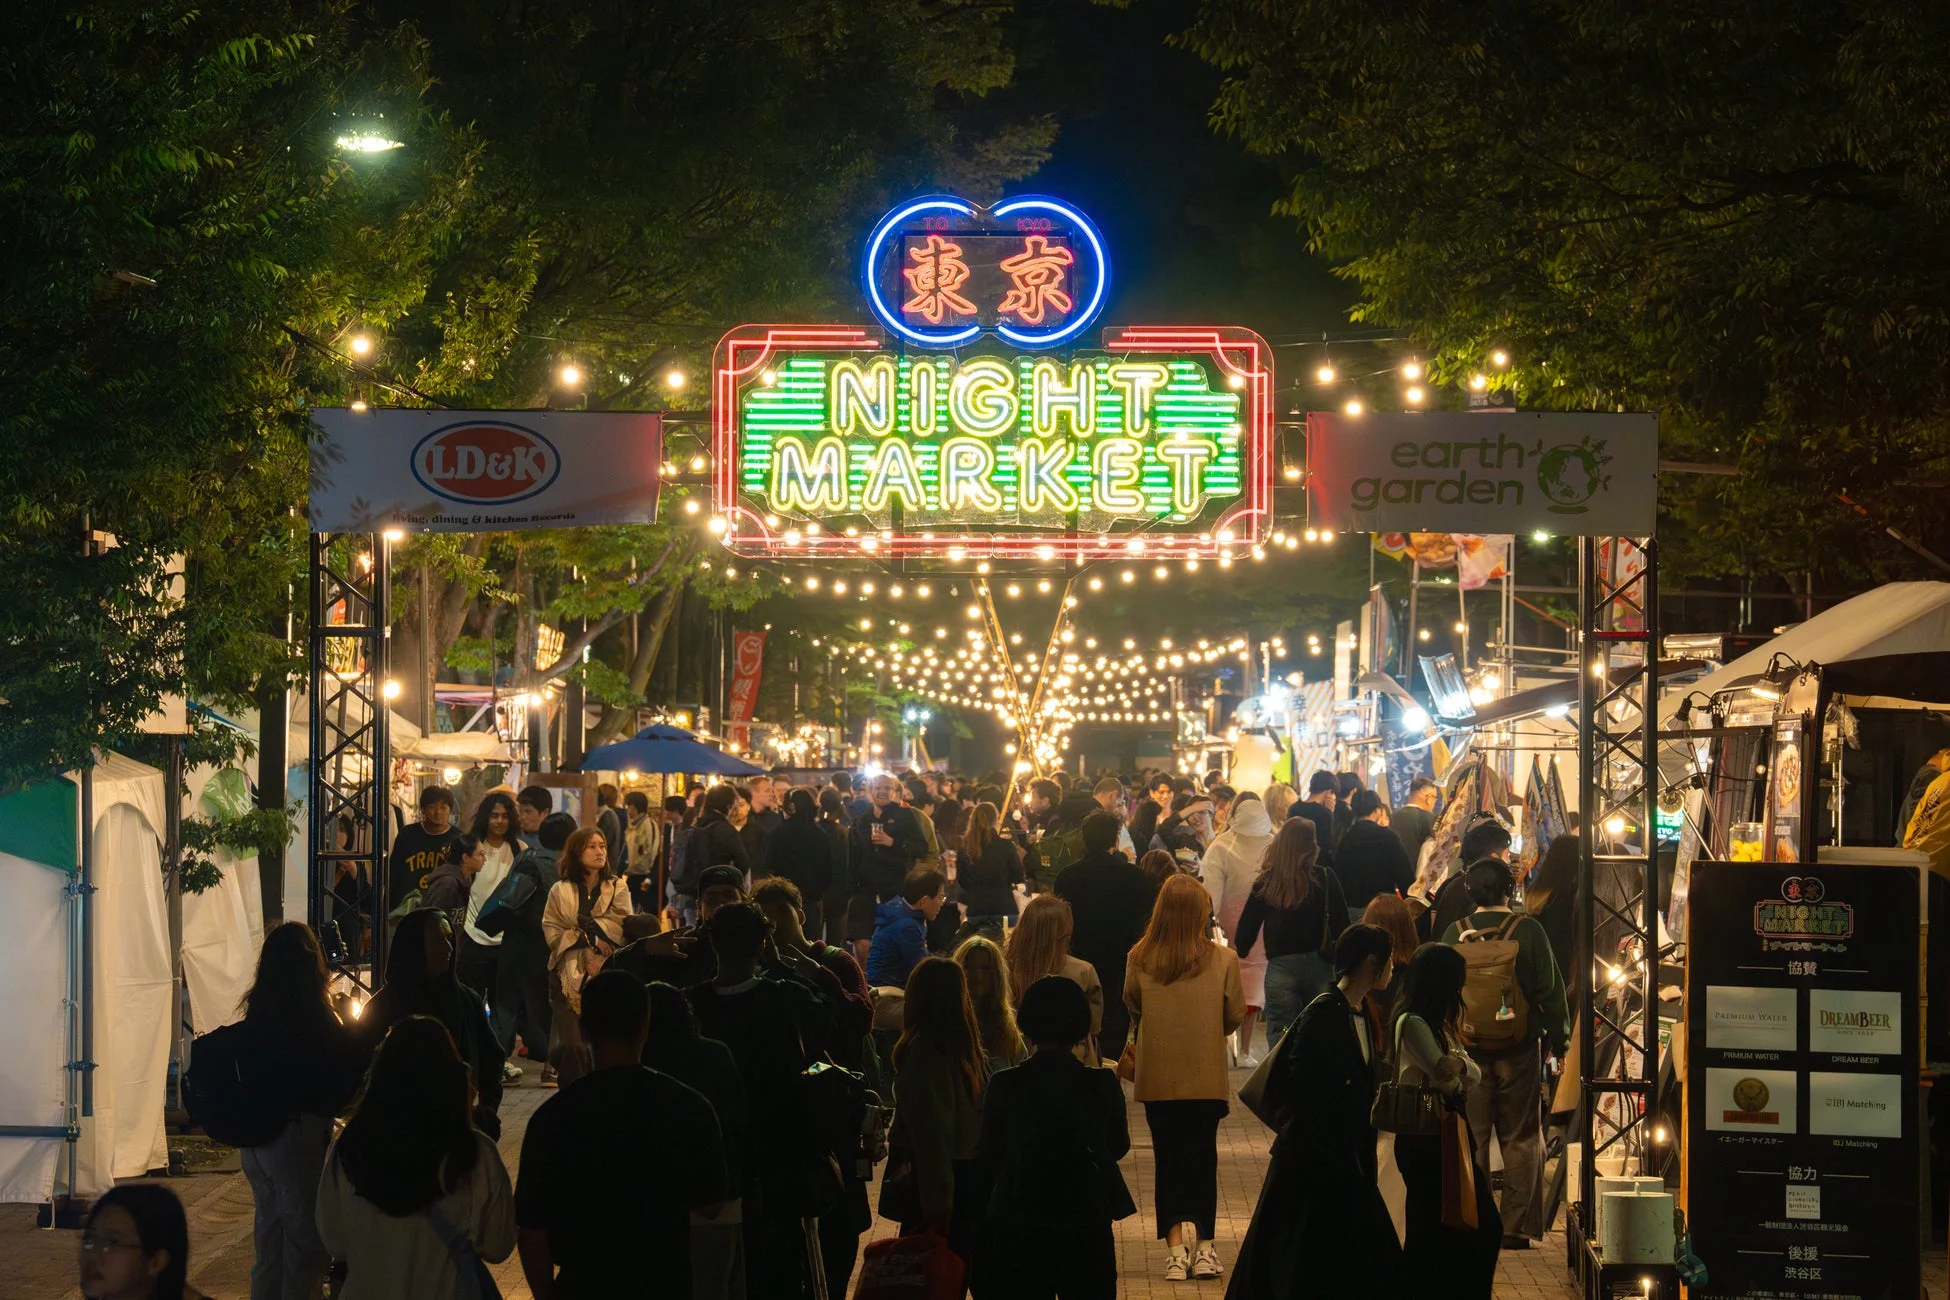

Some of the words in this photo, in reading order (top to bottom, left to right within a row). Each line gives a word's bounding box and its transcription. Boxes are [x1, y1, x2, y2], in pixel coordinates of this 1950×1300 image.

[923, 217, 949, 231] TO
[1017, 217, 1051, 232] KYO
[902, 234, 1074, 324] 東京
[831, 361, 1168, 438] NIGHT
[1390, 433, 1524, 469] earth
[432, 446, 545, 480] LD&K
[771, 437, 1217, 513] MARKET
[1351, 470, 1524, 511] garden
[432, 514, 469, 525] dining
[485, 514, 528, 524] kitchen
[1773, 905, 1836, 921] NIGHT
[1763, 918, 1845, 935] MARKET
[1787, 961, 1817, 976] 協賛
[1755, 1053, 1780, 1061] WATER
[1832, 1055, 1858, 1063] DREAM
[1860, 1056, 1880, 1064] BEER
[1846, 1099, 1886, 1111] Matching
[1787, 1165, 1817, 1181] 協力
[1788, 1245, 1819, 1261] 後援
[1784, 1266, 1823, 1280] 渋谷区
